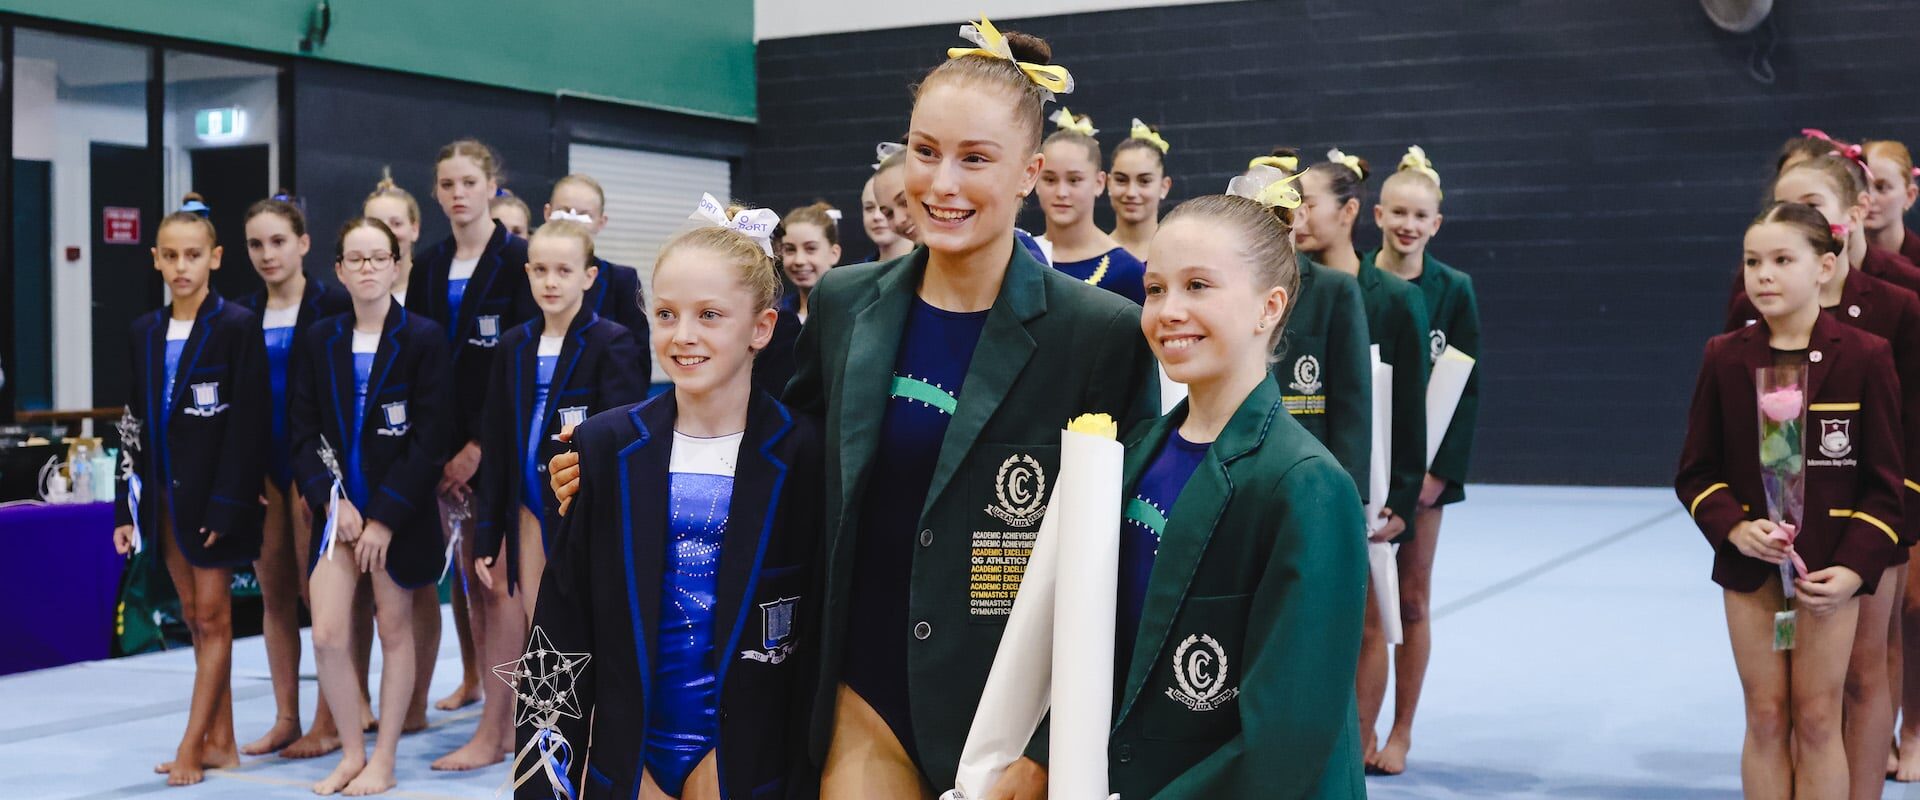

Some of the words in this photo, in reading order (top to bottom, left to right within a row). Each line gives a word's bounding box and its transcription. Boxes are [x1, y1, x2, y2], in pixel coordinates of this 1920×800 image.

[972, 531, 1001, 540] ACADEMIC
[972, 540, 1001, 548] ACADEMIC
[972, 548, 1003, 556] ACADEMIC
[971, 556, 984, 565] QG
[986, 556, 1027, 565] ATHLETICS
[971, 565, 1002, 573] ACADEMIC
[971, 574, 1002, 582] ACADEMIC
[970, 599, 1012, 607] GYMNASTICS
[970, 608, 1012, 616] GYMNASTICS
